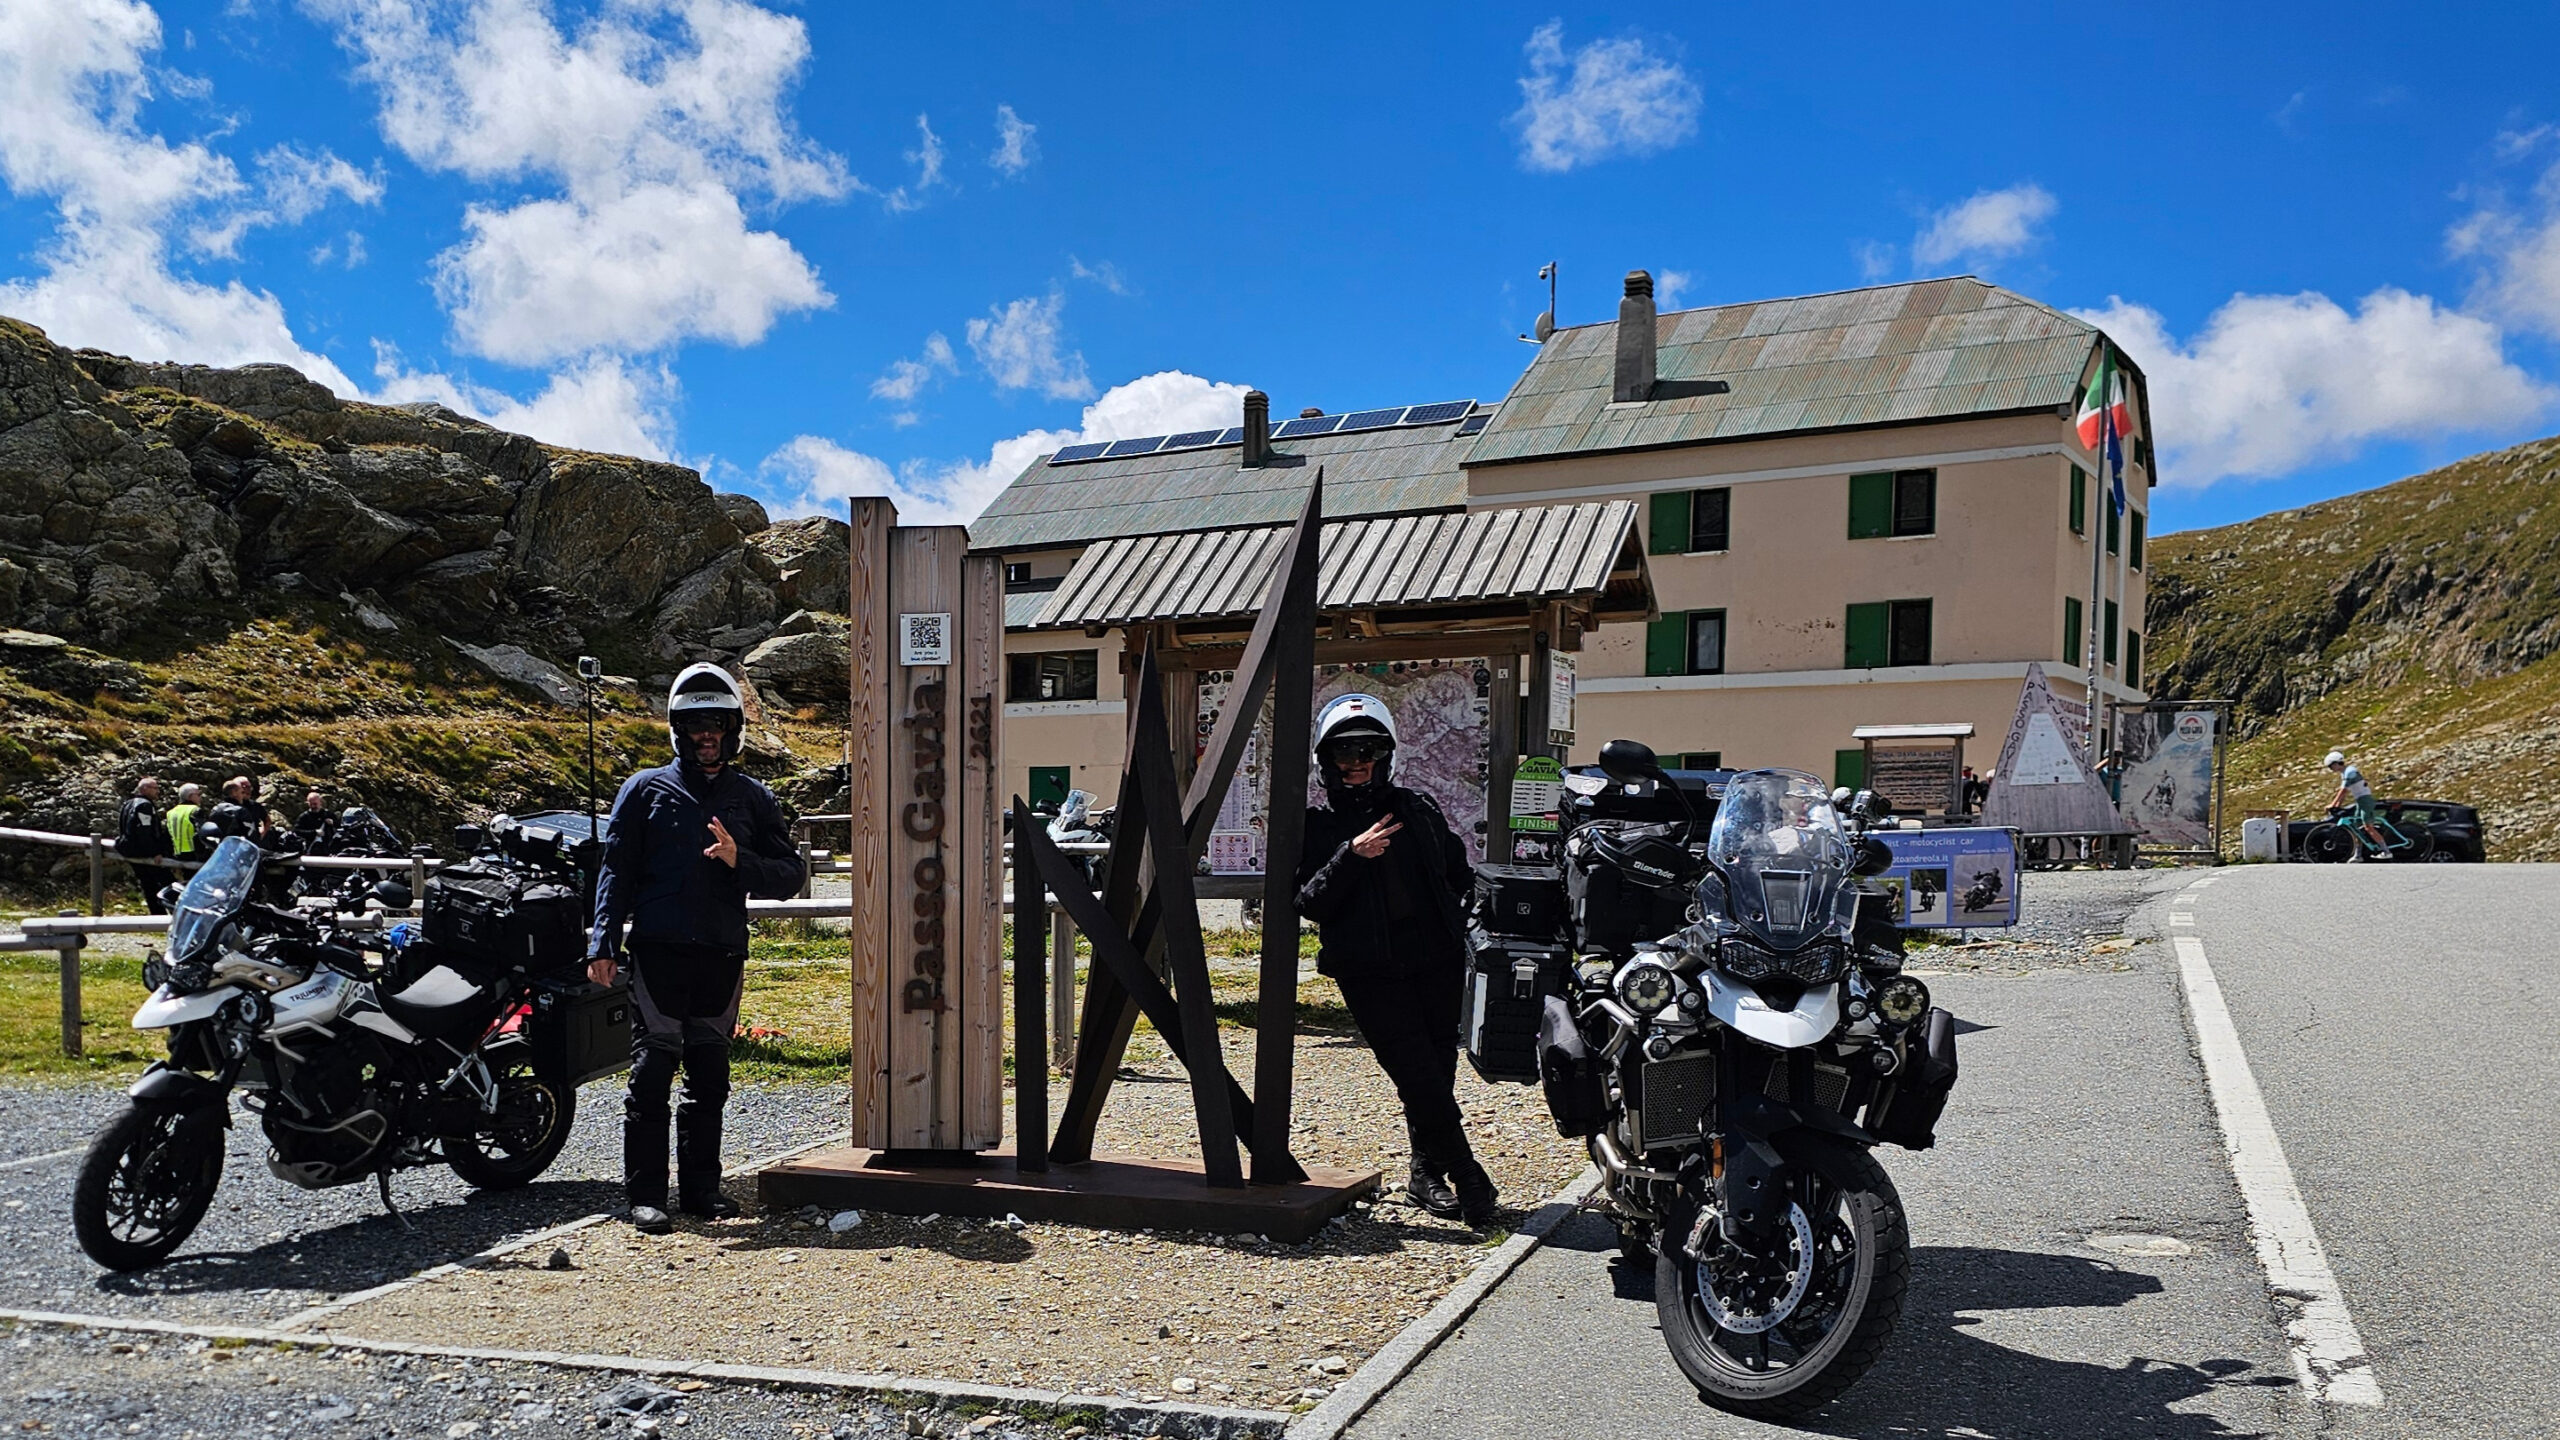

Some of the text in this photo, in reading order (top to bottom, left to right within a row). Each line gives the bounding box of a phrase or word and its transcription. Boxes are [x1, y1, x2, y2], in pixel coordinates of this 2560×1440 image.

[970, 693, 992, 759] 2621
[1999, 682, 2035, 779] PASSO GAVIA
[2038, 681, 2093, 776] VALFURVA
[1526, 766, 1556, 774] GAVIA
[1517, 819, 1556, 829] FINISH
[1910, 838, 1956, 847] motocyclist
[903, 680, 946, 1014] Passo Gavia
[289, 985, 327, 1002] TRIUMPH
